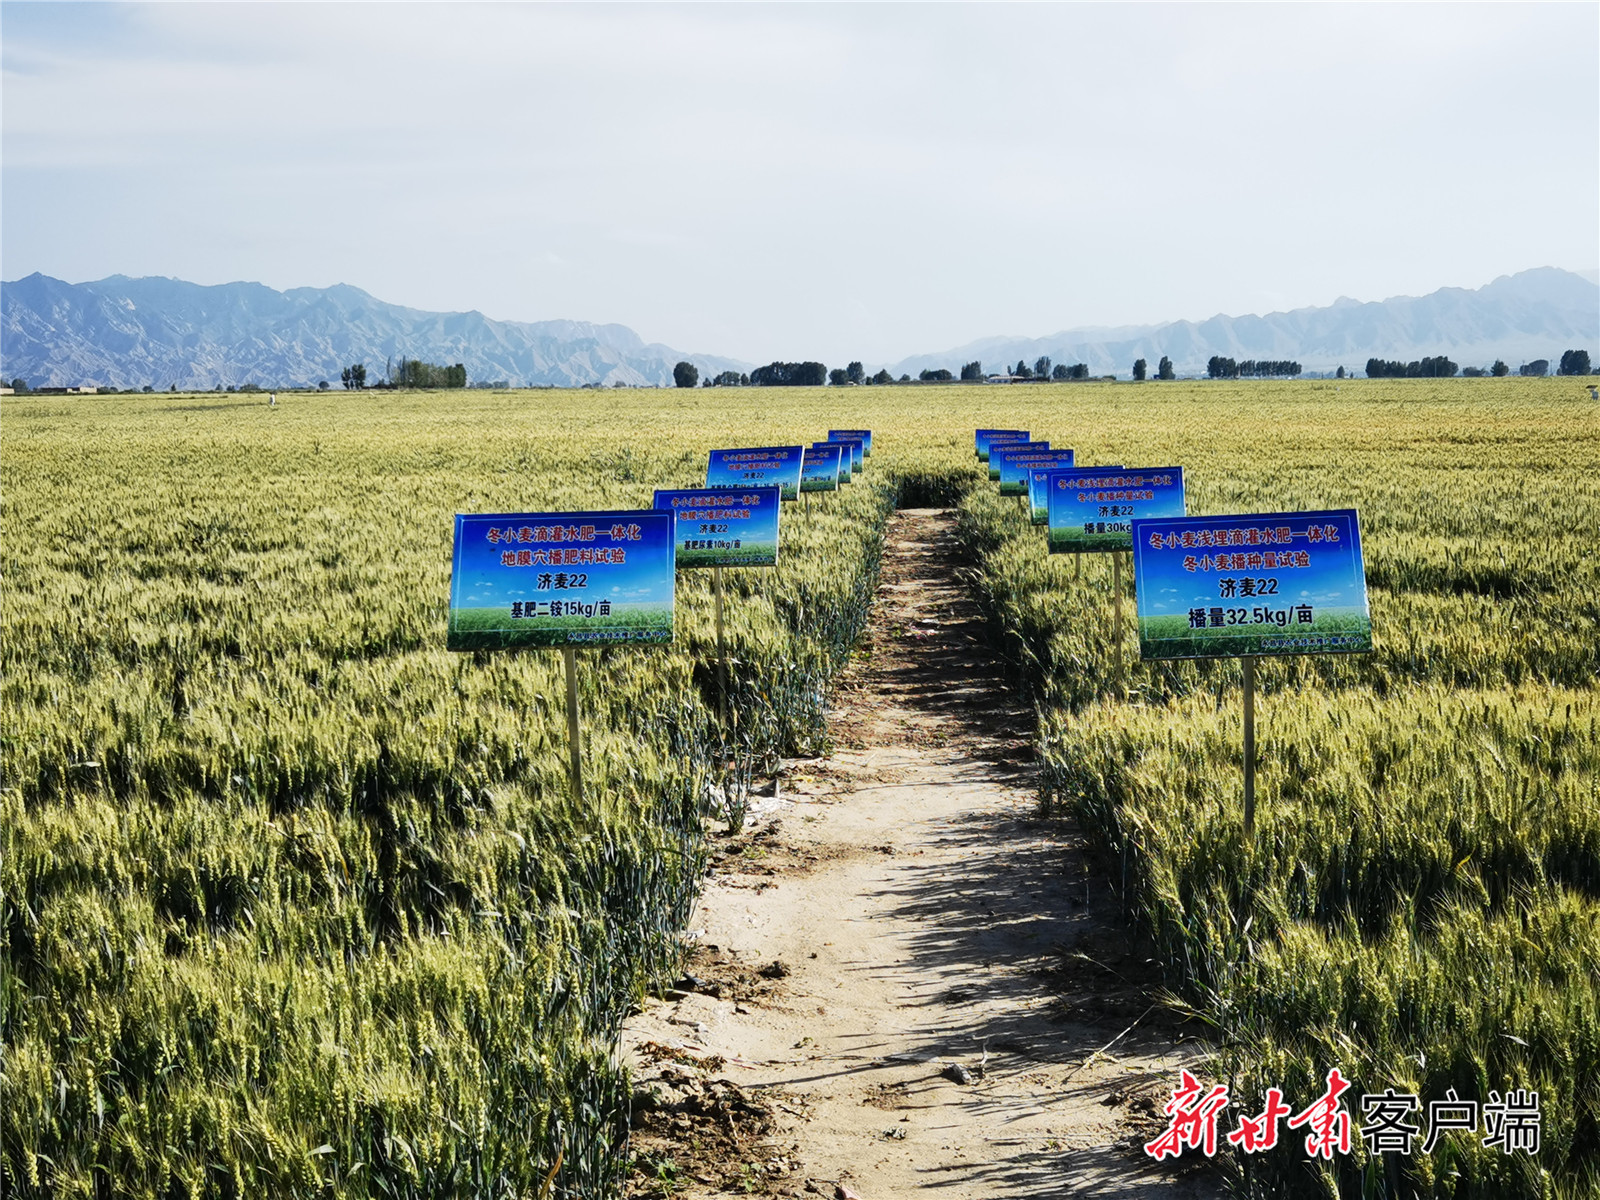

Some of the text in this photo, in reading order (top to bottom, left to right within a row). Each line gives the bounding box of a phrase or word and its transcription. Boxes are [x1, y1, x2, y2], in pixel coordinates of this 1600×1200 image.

[1058, 475, 1173, 490] 冬小麦浅埋滴灌水肥一体化
[671, 495, 761, 507] 冬小麦滴灌水肥一体化
[1077, 490, 1154, 502] 冬小麦播种量试验
[1098, 505, 1134, 517] 济麦22
[487, 523, 642, 544] 冬小麦滴灌水肥一体化
[699, 524, 729, 534] 济麦22
[1149, 524, 1340, 550] 冬小麦浅埋滴灌水肥一体化
[684, 539, 742, 550] 基肥尿素10kg/亩
[501, 548, 626, 567] 地膜穴播肥料试验
[1182, 550, 1311, 573] 冬小麦播种量试验
[537, 573, 588, 590] 济麦22
[1218, 578, 1279, 598] 济麦22
[510, 599, 612, 619] 基肥二铵15kg/亩
[1188, 603, 1313, 629] 播量32.5kg/亩
